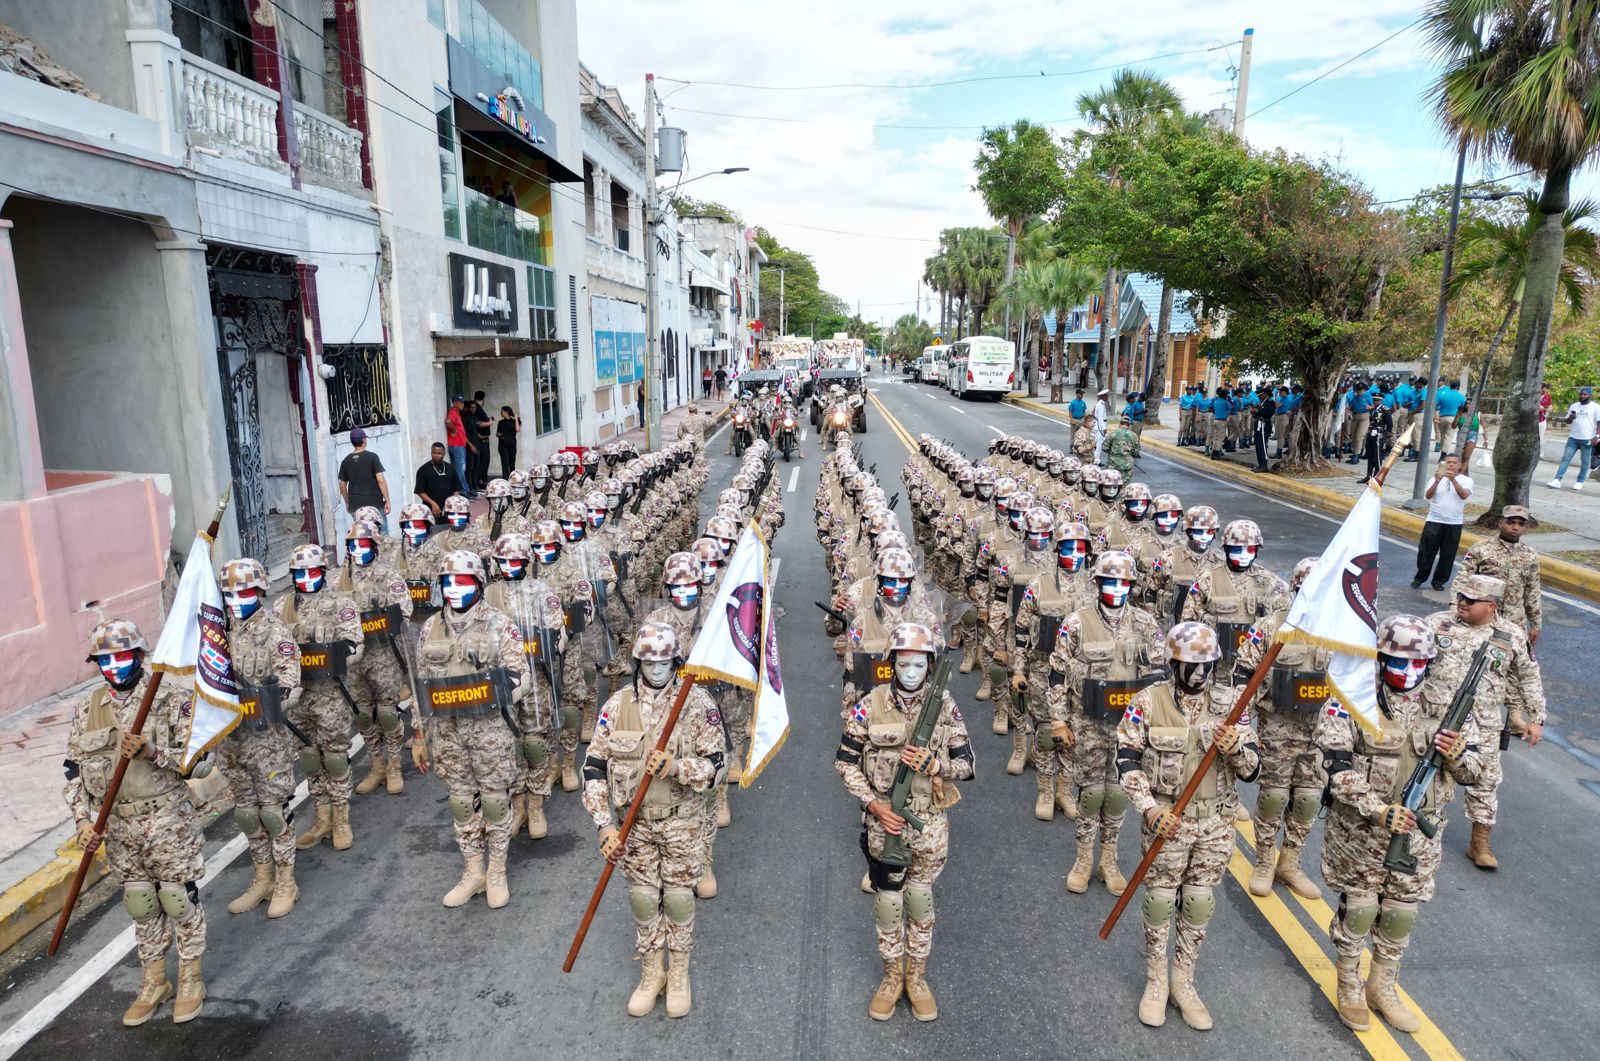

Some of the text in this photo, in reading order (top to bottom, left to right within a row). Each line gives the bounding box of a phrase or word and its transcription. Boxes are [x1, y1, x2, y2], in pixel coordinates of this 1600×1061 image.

[1350, 583, 1371, 612] SEGURIDAD
[733, 616, 753, 649] SEGURIDAD
[432, 685, 488, 705] CESFRONT
[1299, 685, 1330, 698] CESF
